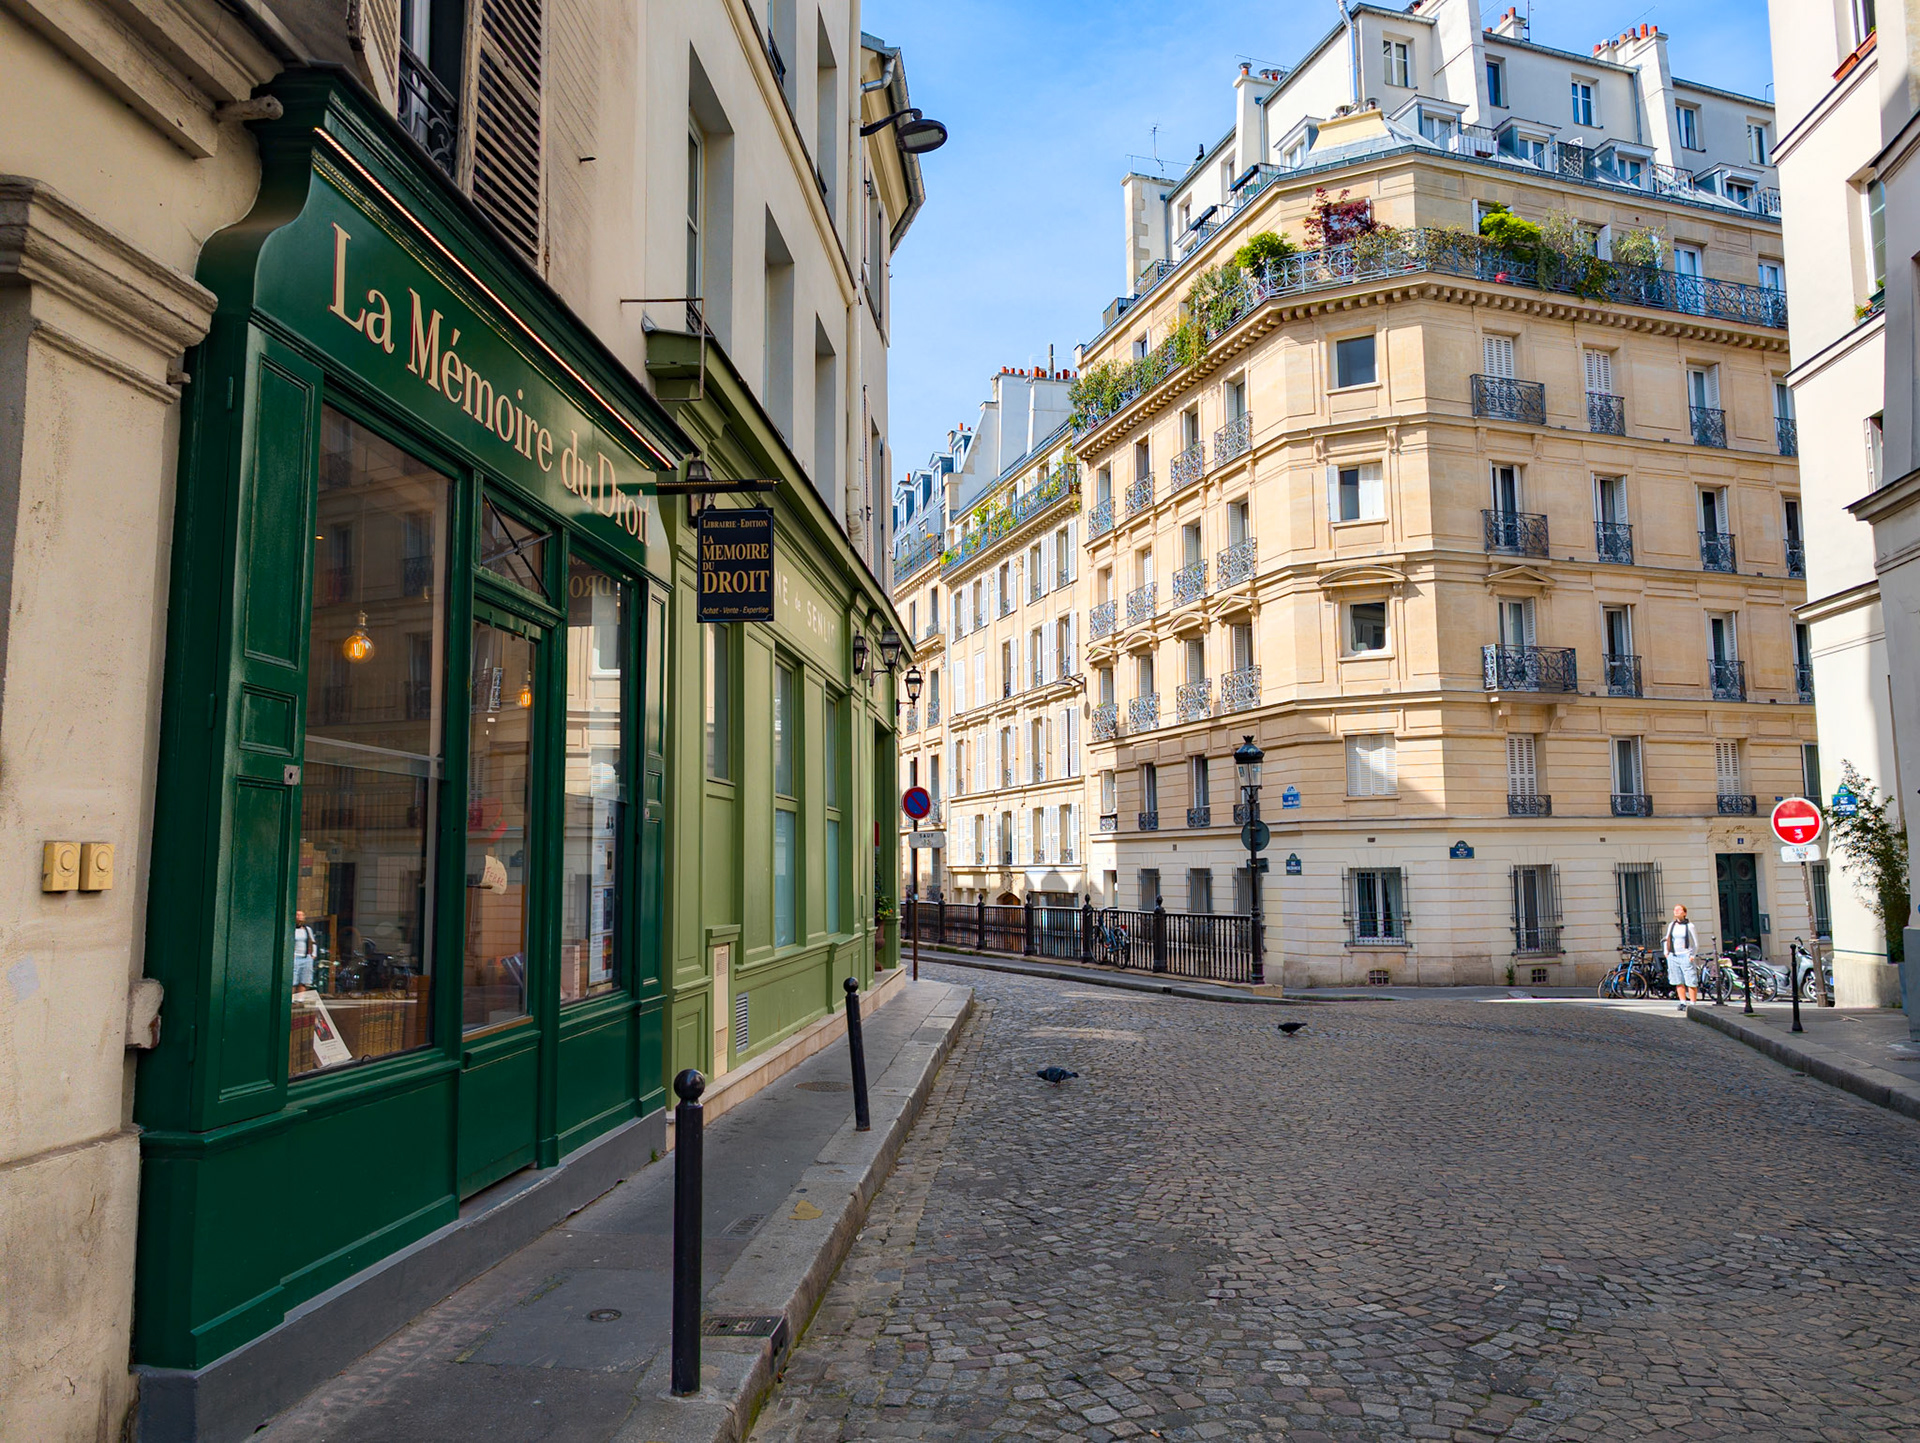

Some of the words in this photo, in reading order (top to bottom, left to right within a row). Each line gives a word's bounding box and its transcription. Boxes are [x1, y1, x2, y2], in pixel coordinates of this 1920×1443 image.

[327, 221, 395, 354] La
[406, 287, 554, 472] Mémoire
[560, 429, 592, 505] du
[597, 452, 651, 547] Droit
[703, 519, 737, 529] LIBRAIRIE
[702, 535, 714, 545] LA
[702, 543, 769, 560] MEMOIRE
[702, 561, 715, 571] DU
[702, 570, 770, 593] DROIT
[702, 607, 719, 615] Achat
[723, 606, 739, 614] Vente
[742, 606, 769, 614] Expertise
